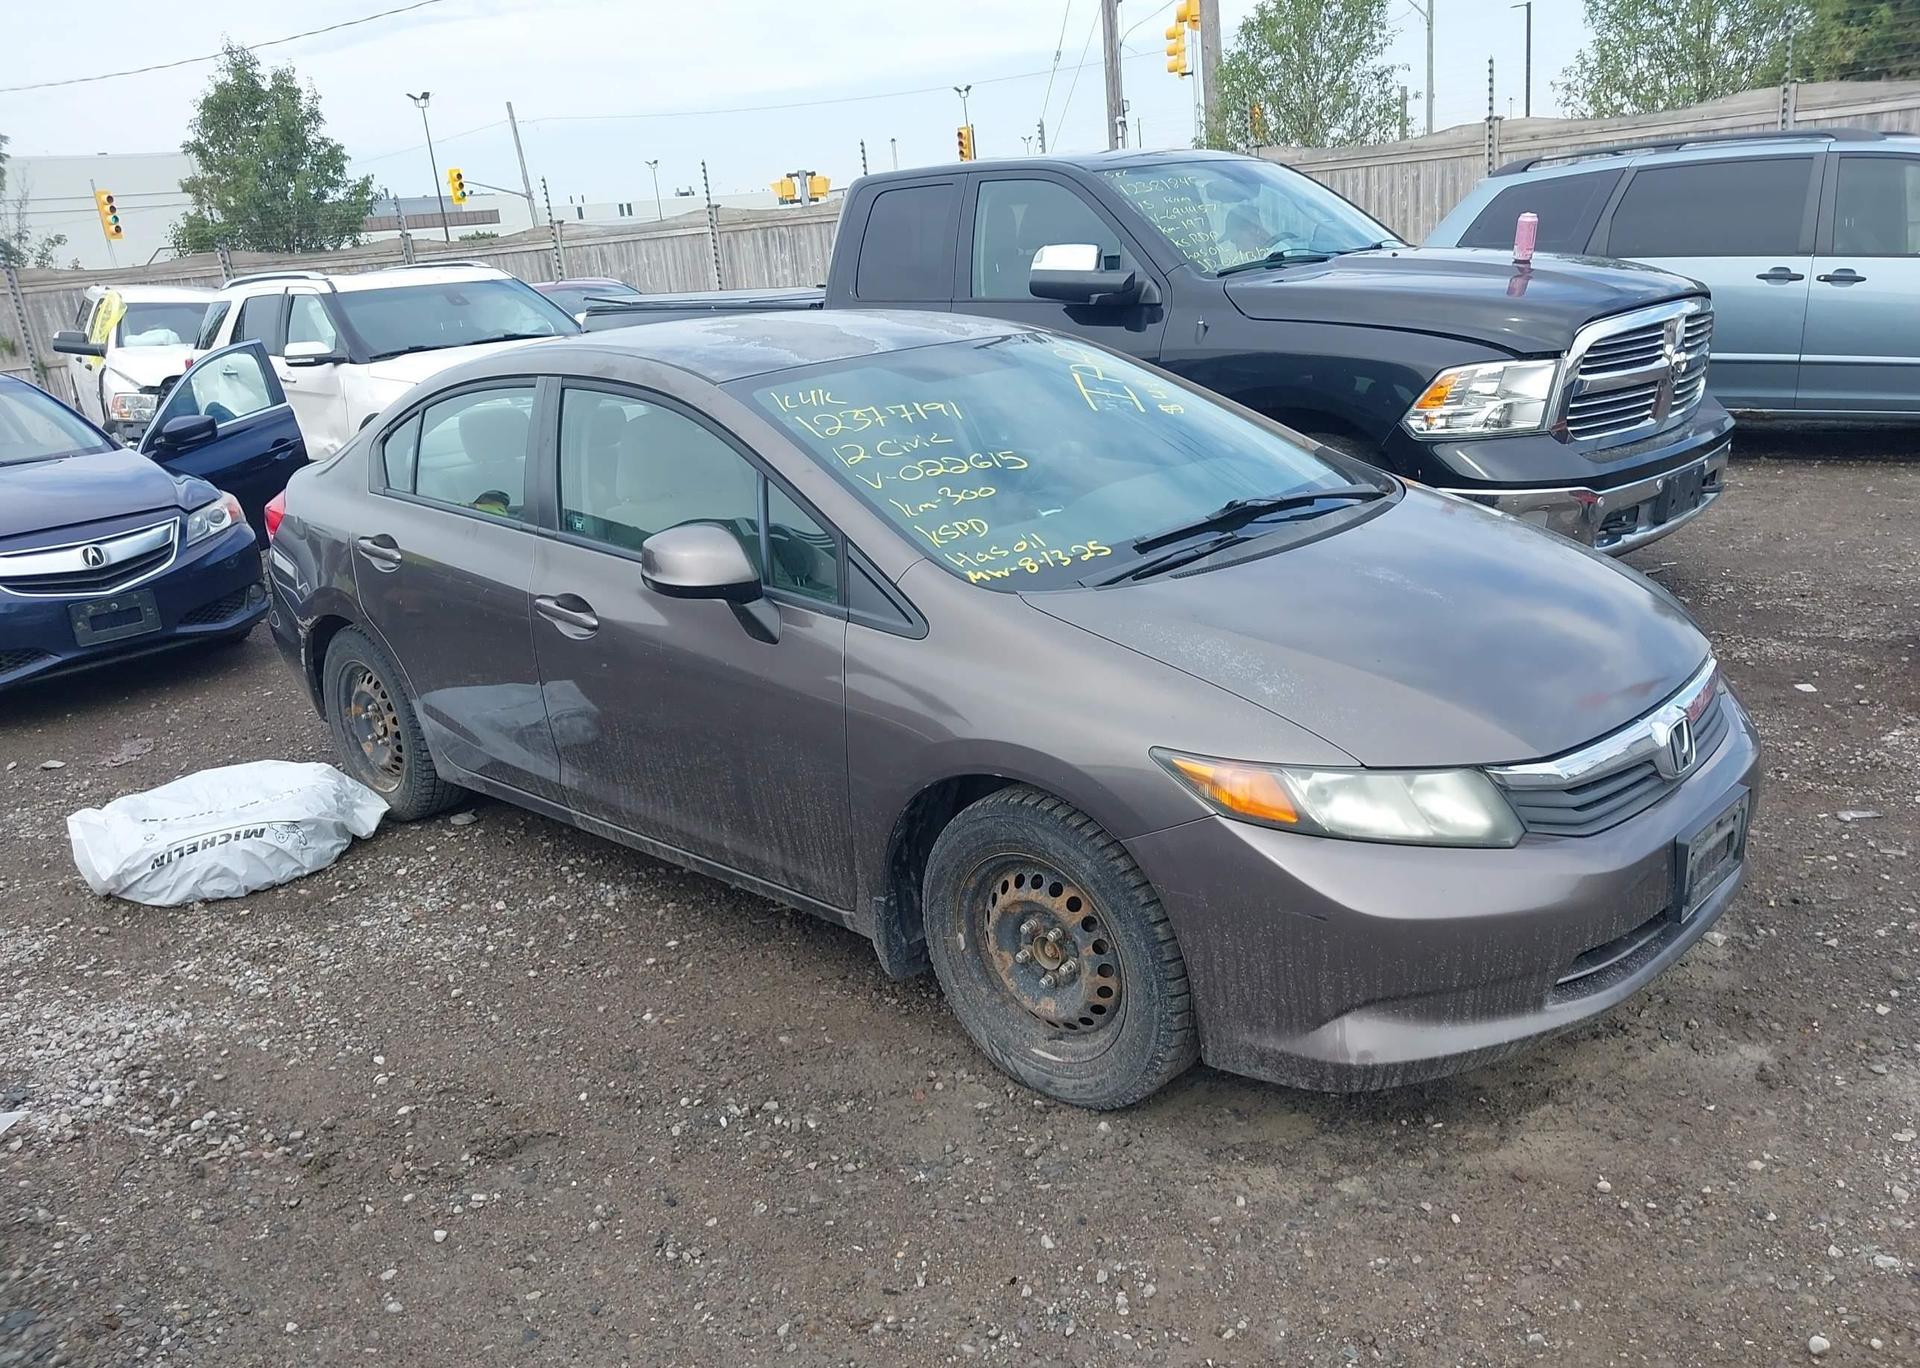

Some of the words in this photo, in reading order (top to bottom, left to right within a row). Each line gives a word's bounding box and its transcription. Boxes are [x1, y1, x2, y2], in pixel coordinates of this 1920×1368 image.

[795, 400, 964, 439] 12377191
[832, 444, 872, 468] 12
[151, 827, 266, 870] MICHELIN
